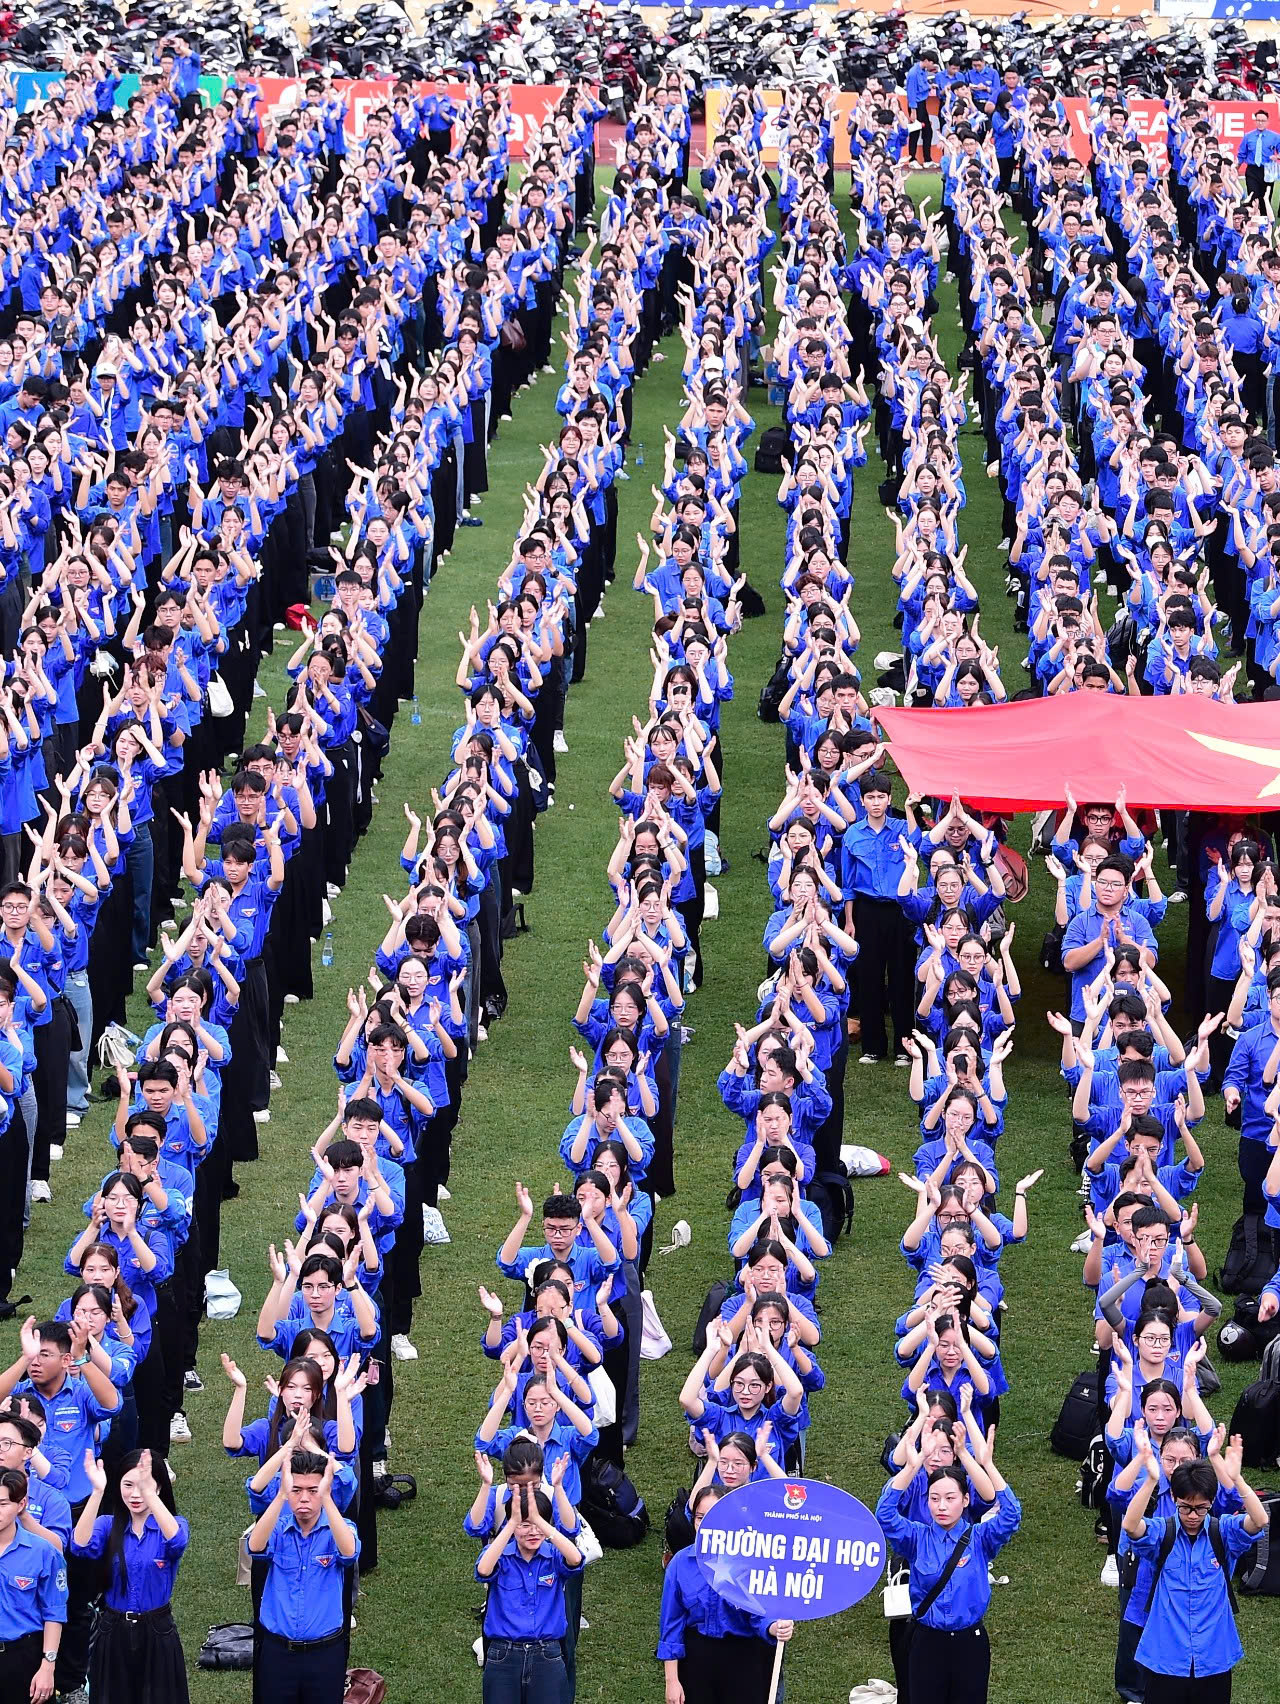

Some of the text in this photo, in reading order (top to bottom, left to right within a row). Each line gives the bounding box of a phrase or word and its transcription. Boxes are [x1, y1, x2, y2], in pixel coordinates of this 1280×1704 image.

[763, 1511, 823, 1522] THÀNH PHỐ HÀ NỘI
[700, 1525, 881, 1571] TRƯỜNG ĐẠI HỌC
[748, 1565, 824, 1605] HÀ NỘI
